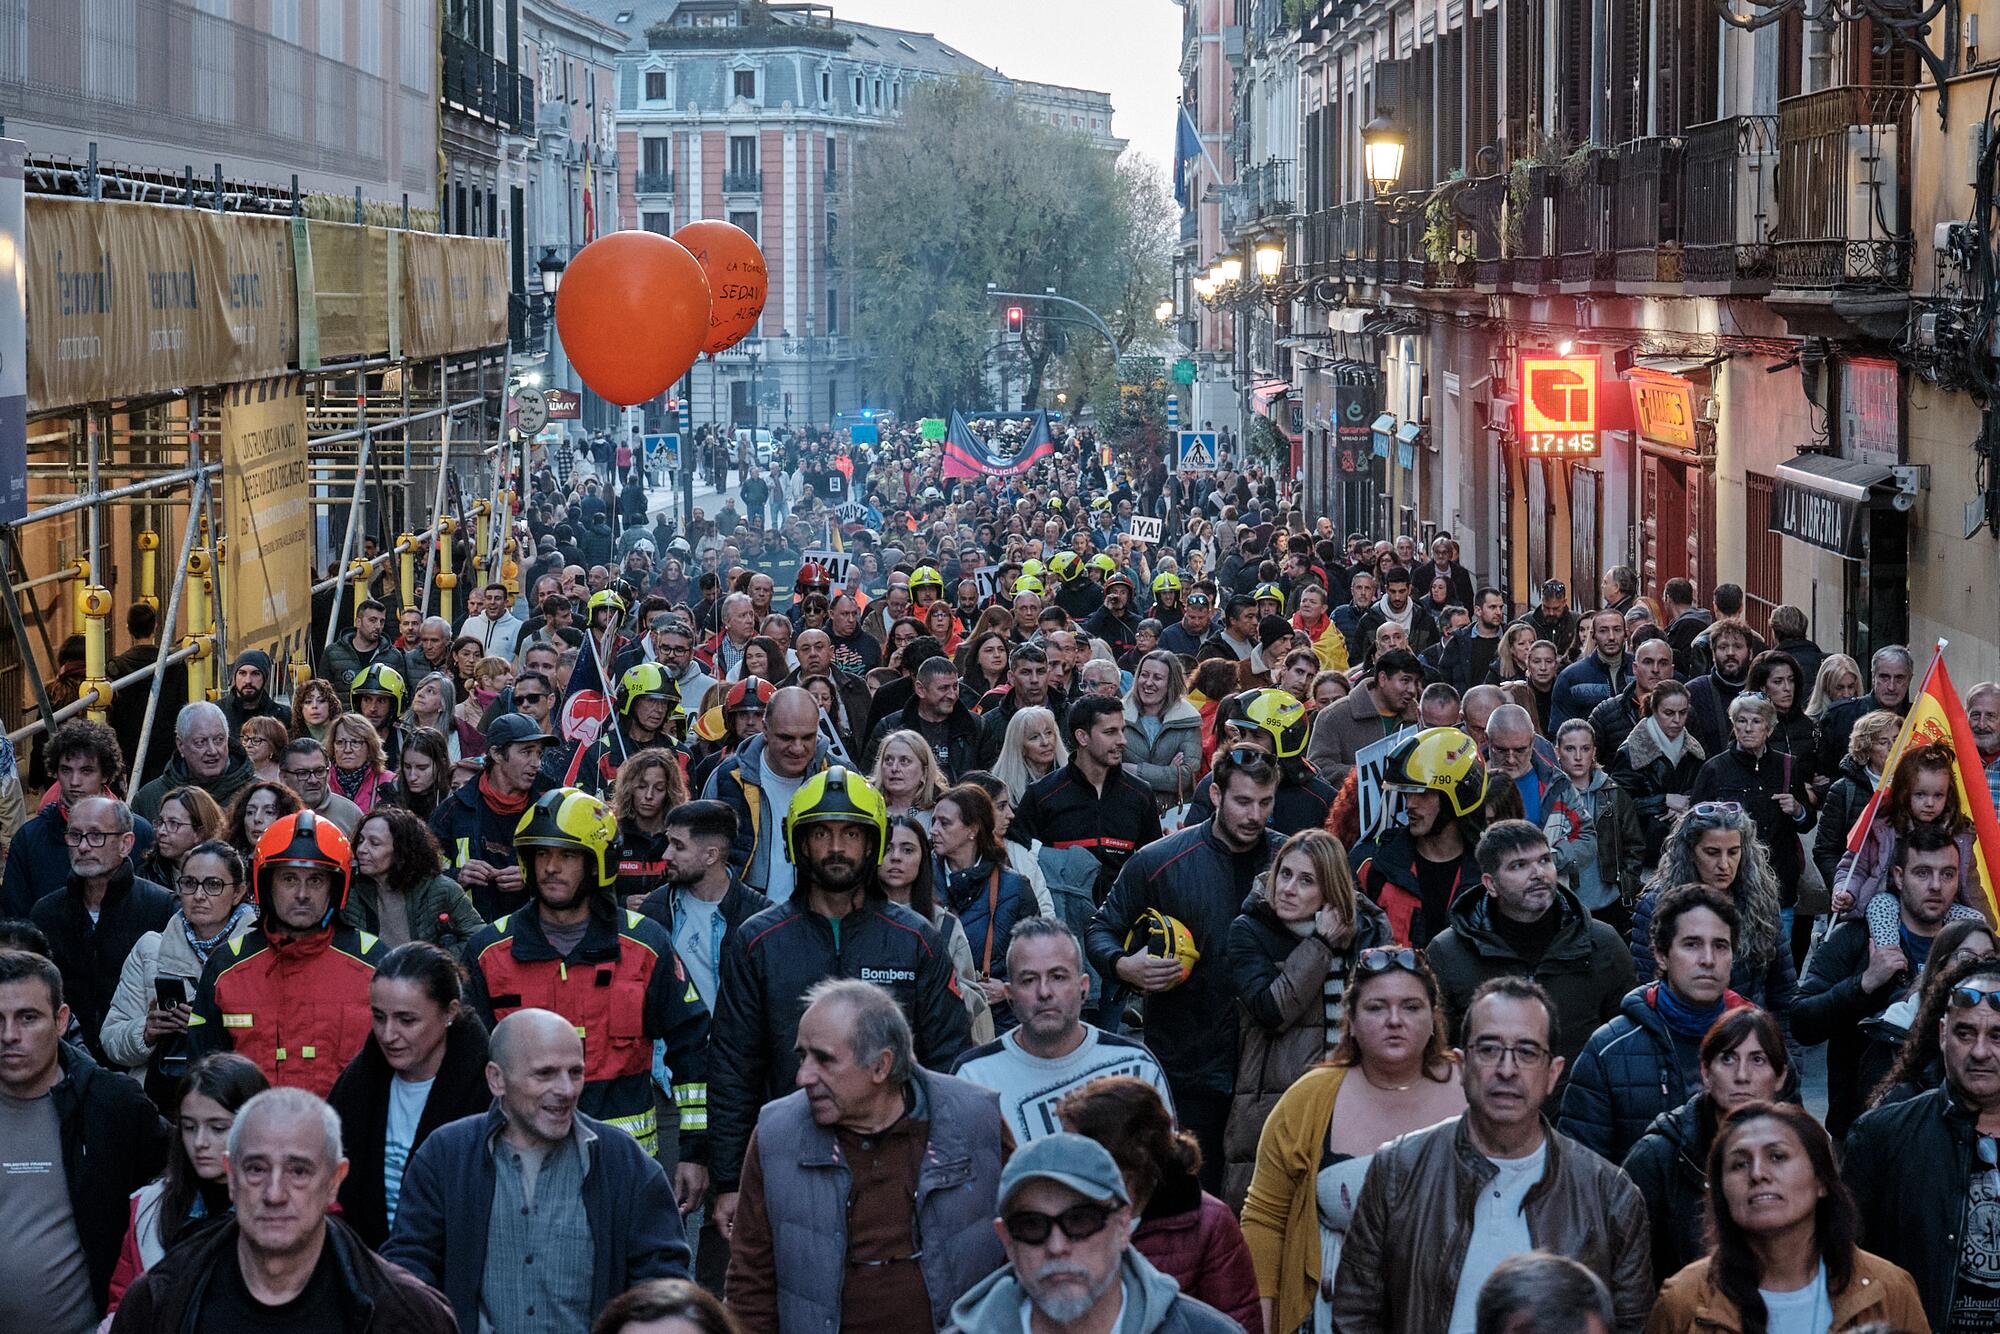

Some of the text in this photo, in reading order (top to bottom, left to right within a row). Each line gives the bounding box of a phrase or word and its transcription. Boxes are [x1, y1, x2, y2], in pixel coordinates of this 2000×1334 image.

[1530, 433, 1595, 452] 17:45
[981, 465, 1019, 476] GALICIA
[1783, 487, 1842, 548] LA LIBRERIA
[1131, 519, 1161, 539] ¡YA!
[631, 683, 644, 691] 515
[1266, 717, 1282, 728] 995
[1432, 775, 1452, 785] 790
[861, 967, 916, 981] Bombers
